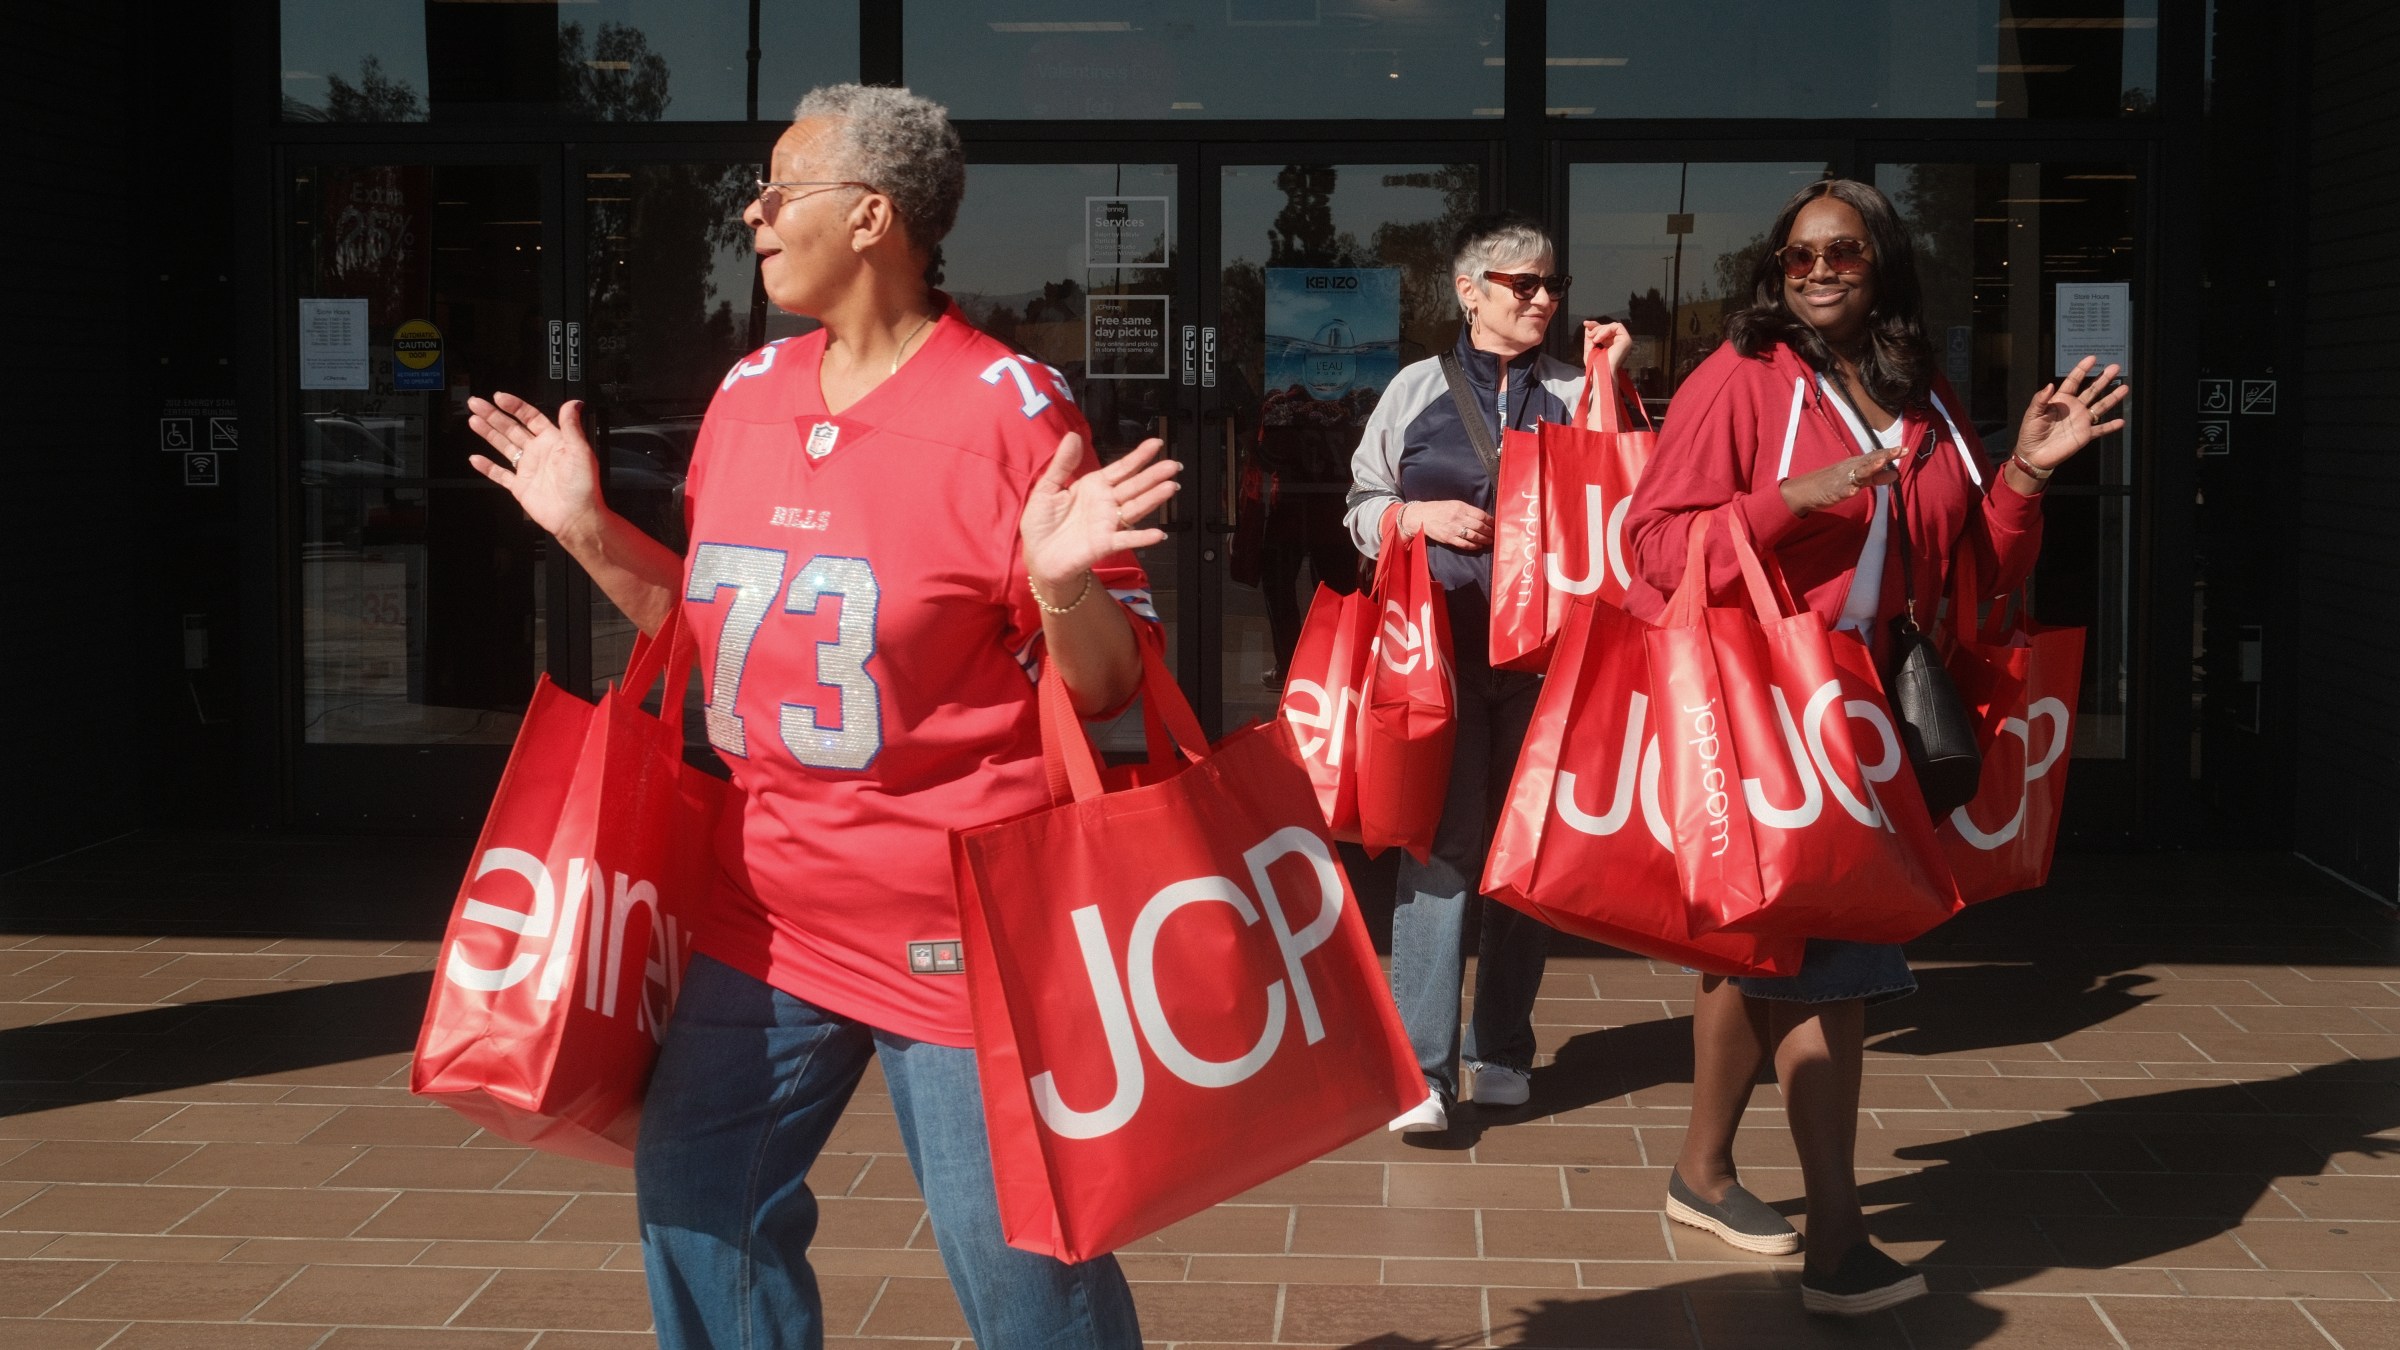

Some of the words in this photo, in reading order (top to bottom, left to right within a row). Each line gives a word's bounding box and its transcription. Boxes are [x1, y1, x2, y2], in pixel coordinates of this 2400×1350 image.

[1095, 217, 1145, 227] Services
[1306, 276, 1358, 289] KENZO
[1095, 316, 1120, 326] Free
[1122, 317, 1152, 326] same
[1095, 327, 1116, 339] day
[1118, 327, 1141, 339] pick
[1143, 329, 1159, 339] up
[398, 341, 437, 349] CAUTION
[551, 325, 561, 365] PULL
[569, 327, 579, 367] PULL
[1185, 330, 1195, 371] PULL
[1204, 332, 1214, 373] PULL
[1316, 361, 1343, 371] L'EAU
[686, 542, 884, 772] 73
[1741, 679, 1901, 834] JCP
[1683, 697, 1729, 857] jcp.com
[1029, 826, 1344, 1139] JCP
